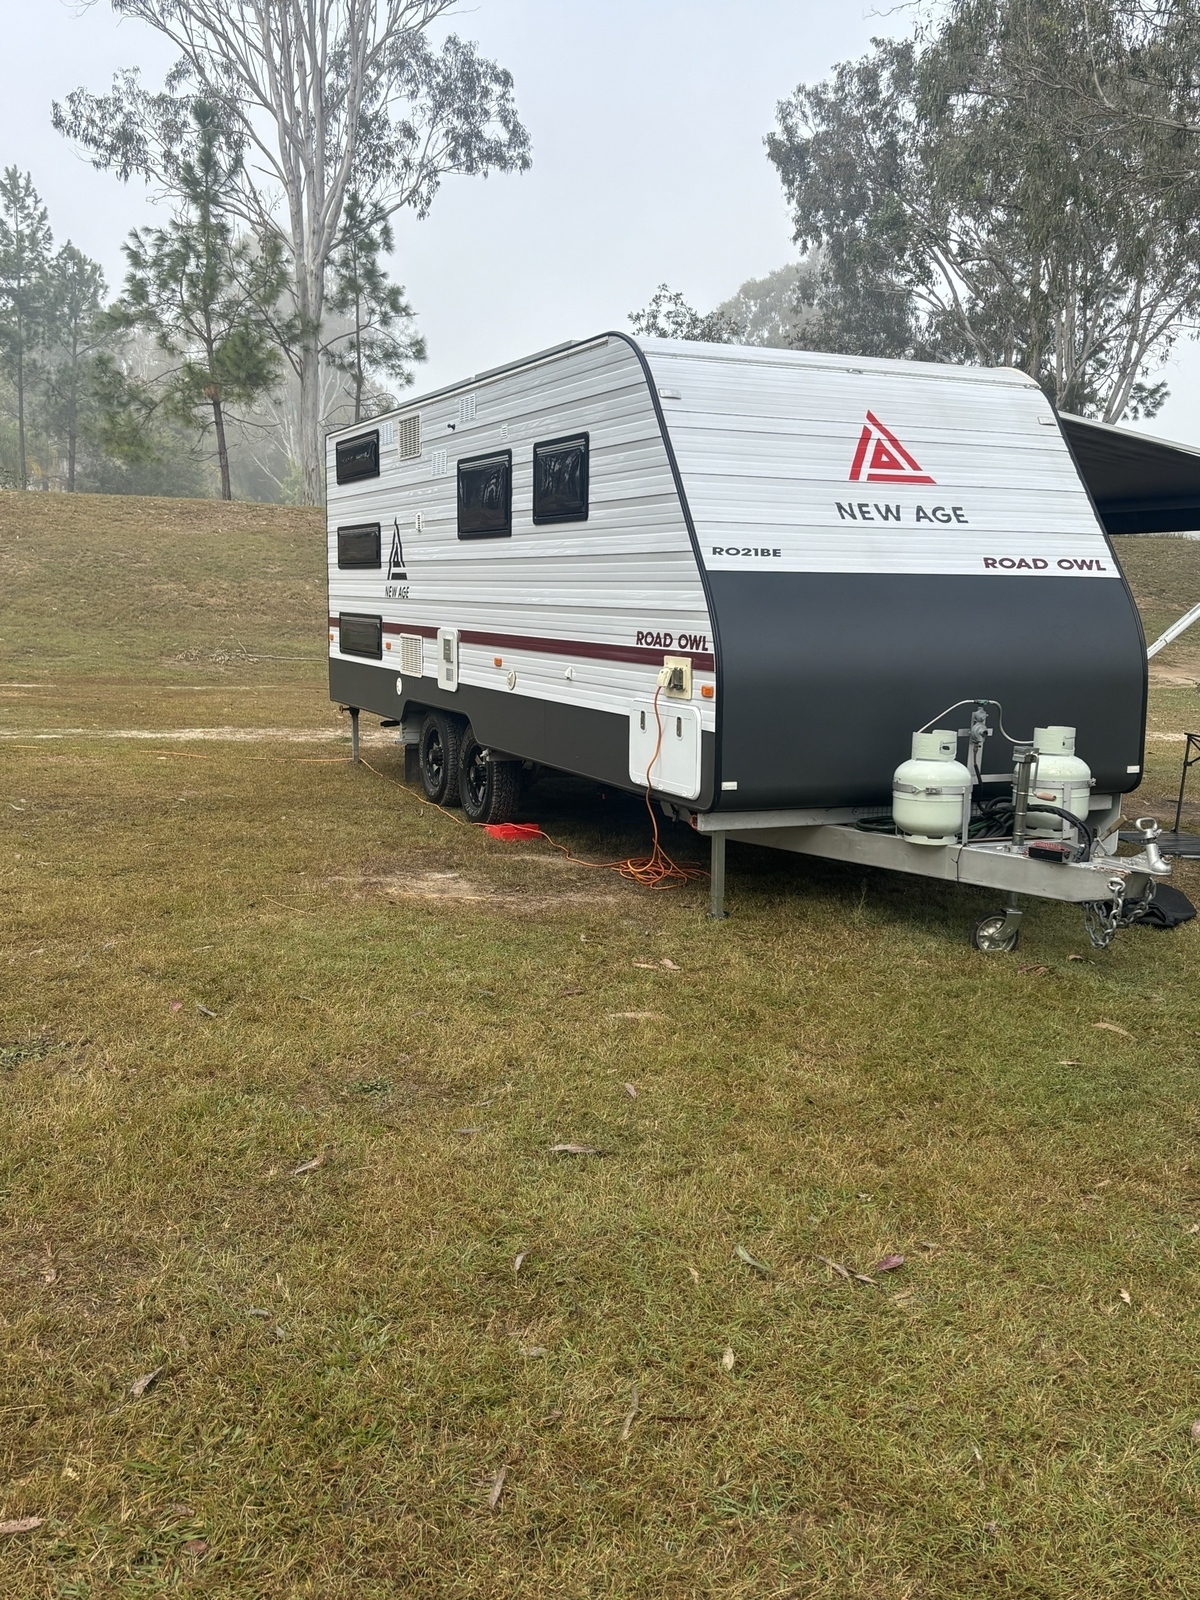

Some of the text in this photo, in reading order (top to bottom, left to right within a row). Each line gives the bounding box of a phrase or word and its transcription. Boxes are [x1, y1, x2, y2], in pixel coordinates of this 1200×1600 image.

[834, 501, 969, 524] NEW AGE
[712, 546, 782, 558] RO21BE
[983, 557, 1107, 571] ROAD OWL
[385, 585, 410, 599] NEW AGE
[636, 630, 709, 652] ROAD OWL
